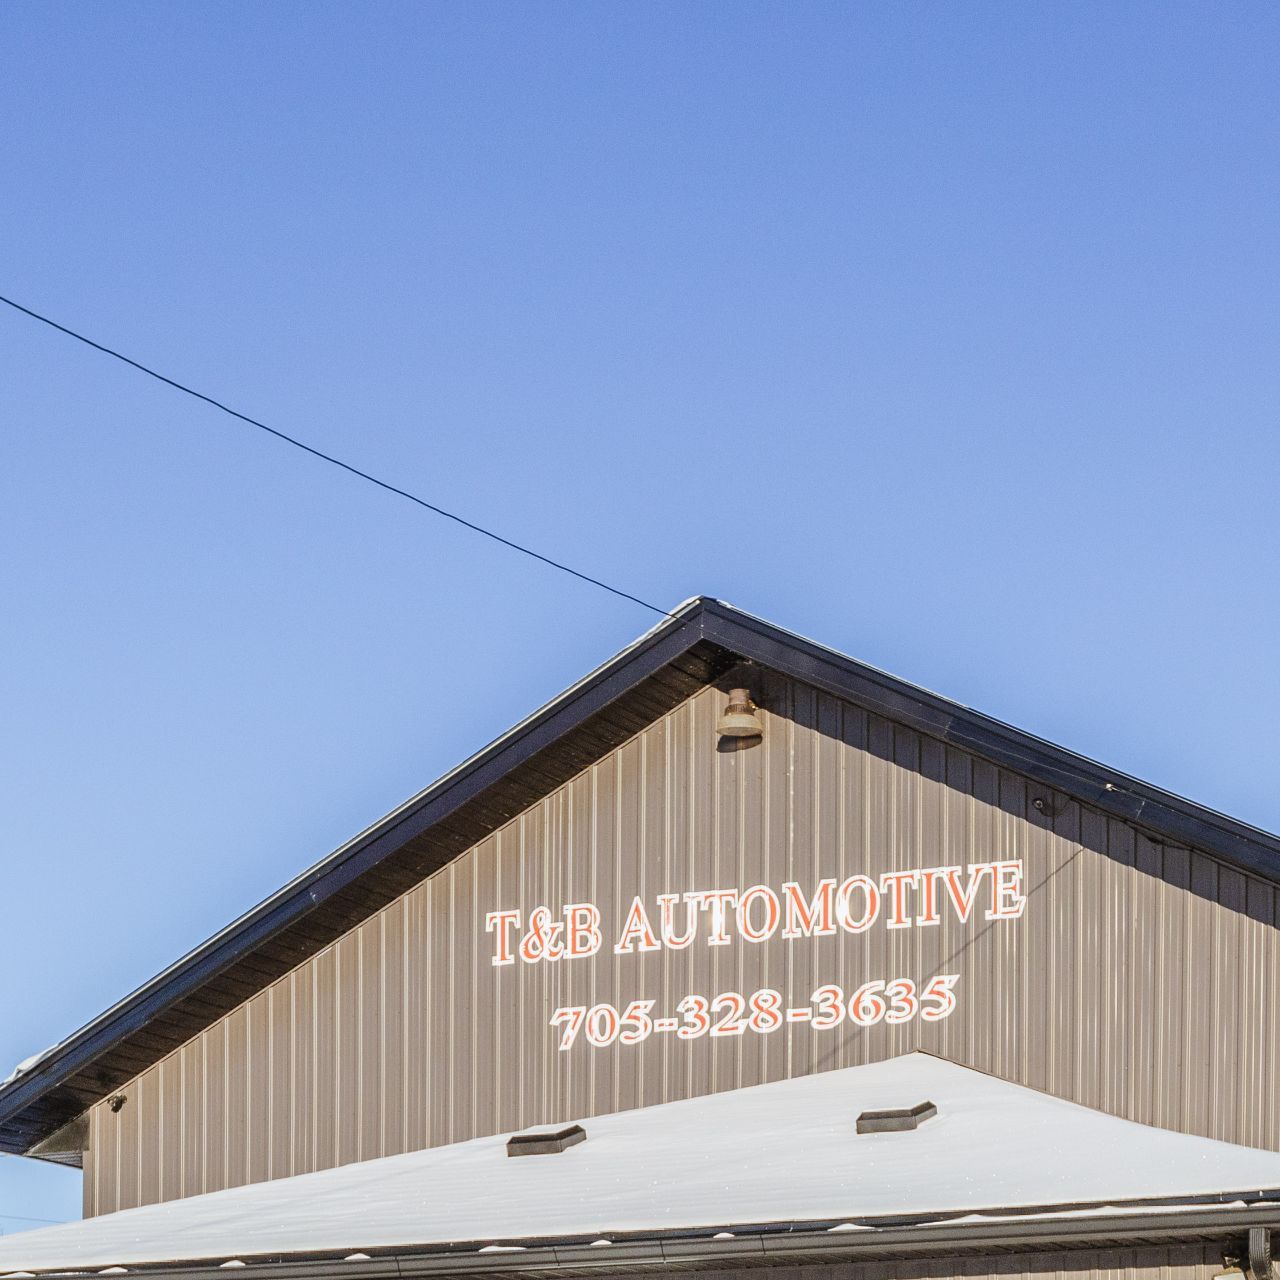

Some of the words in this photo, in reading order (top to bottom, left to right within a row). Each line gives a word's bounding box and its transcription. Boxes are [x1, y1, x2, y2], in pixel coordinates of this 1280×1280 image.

[486, 902, 602, 967] T&B
[614, 858, 1028, 955] AUTOMOTIVE
[549, 974, 961, 1052] 705-328-3635
